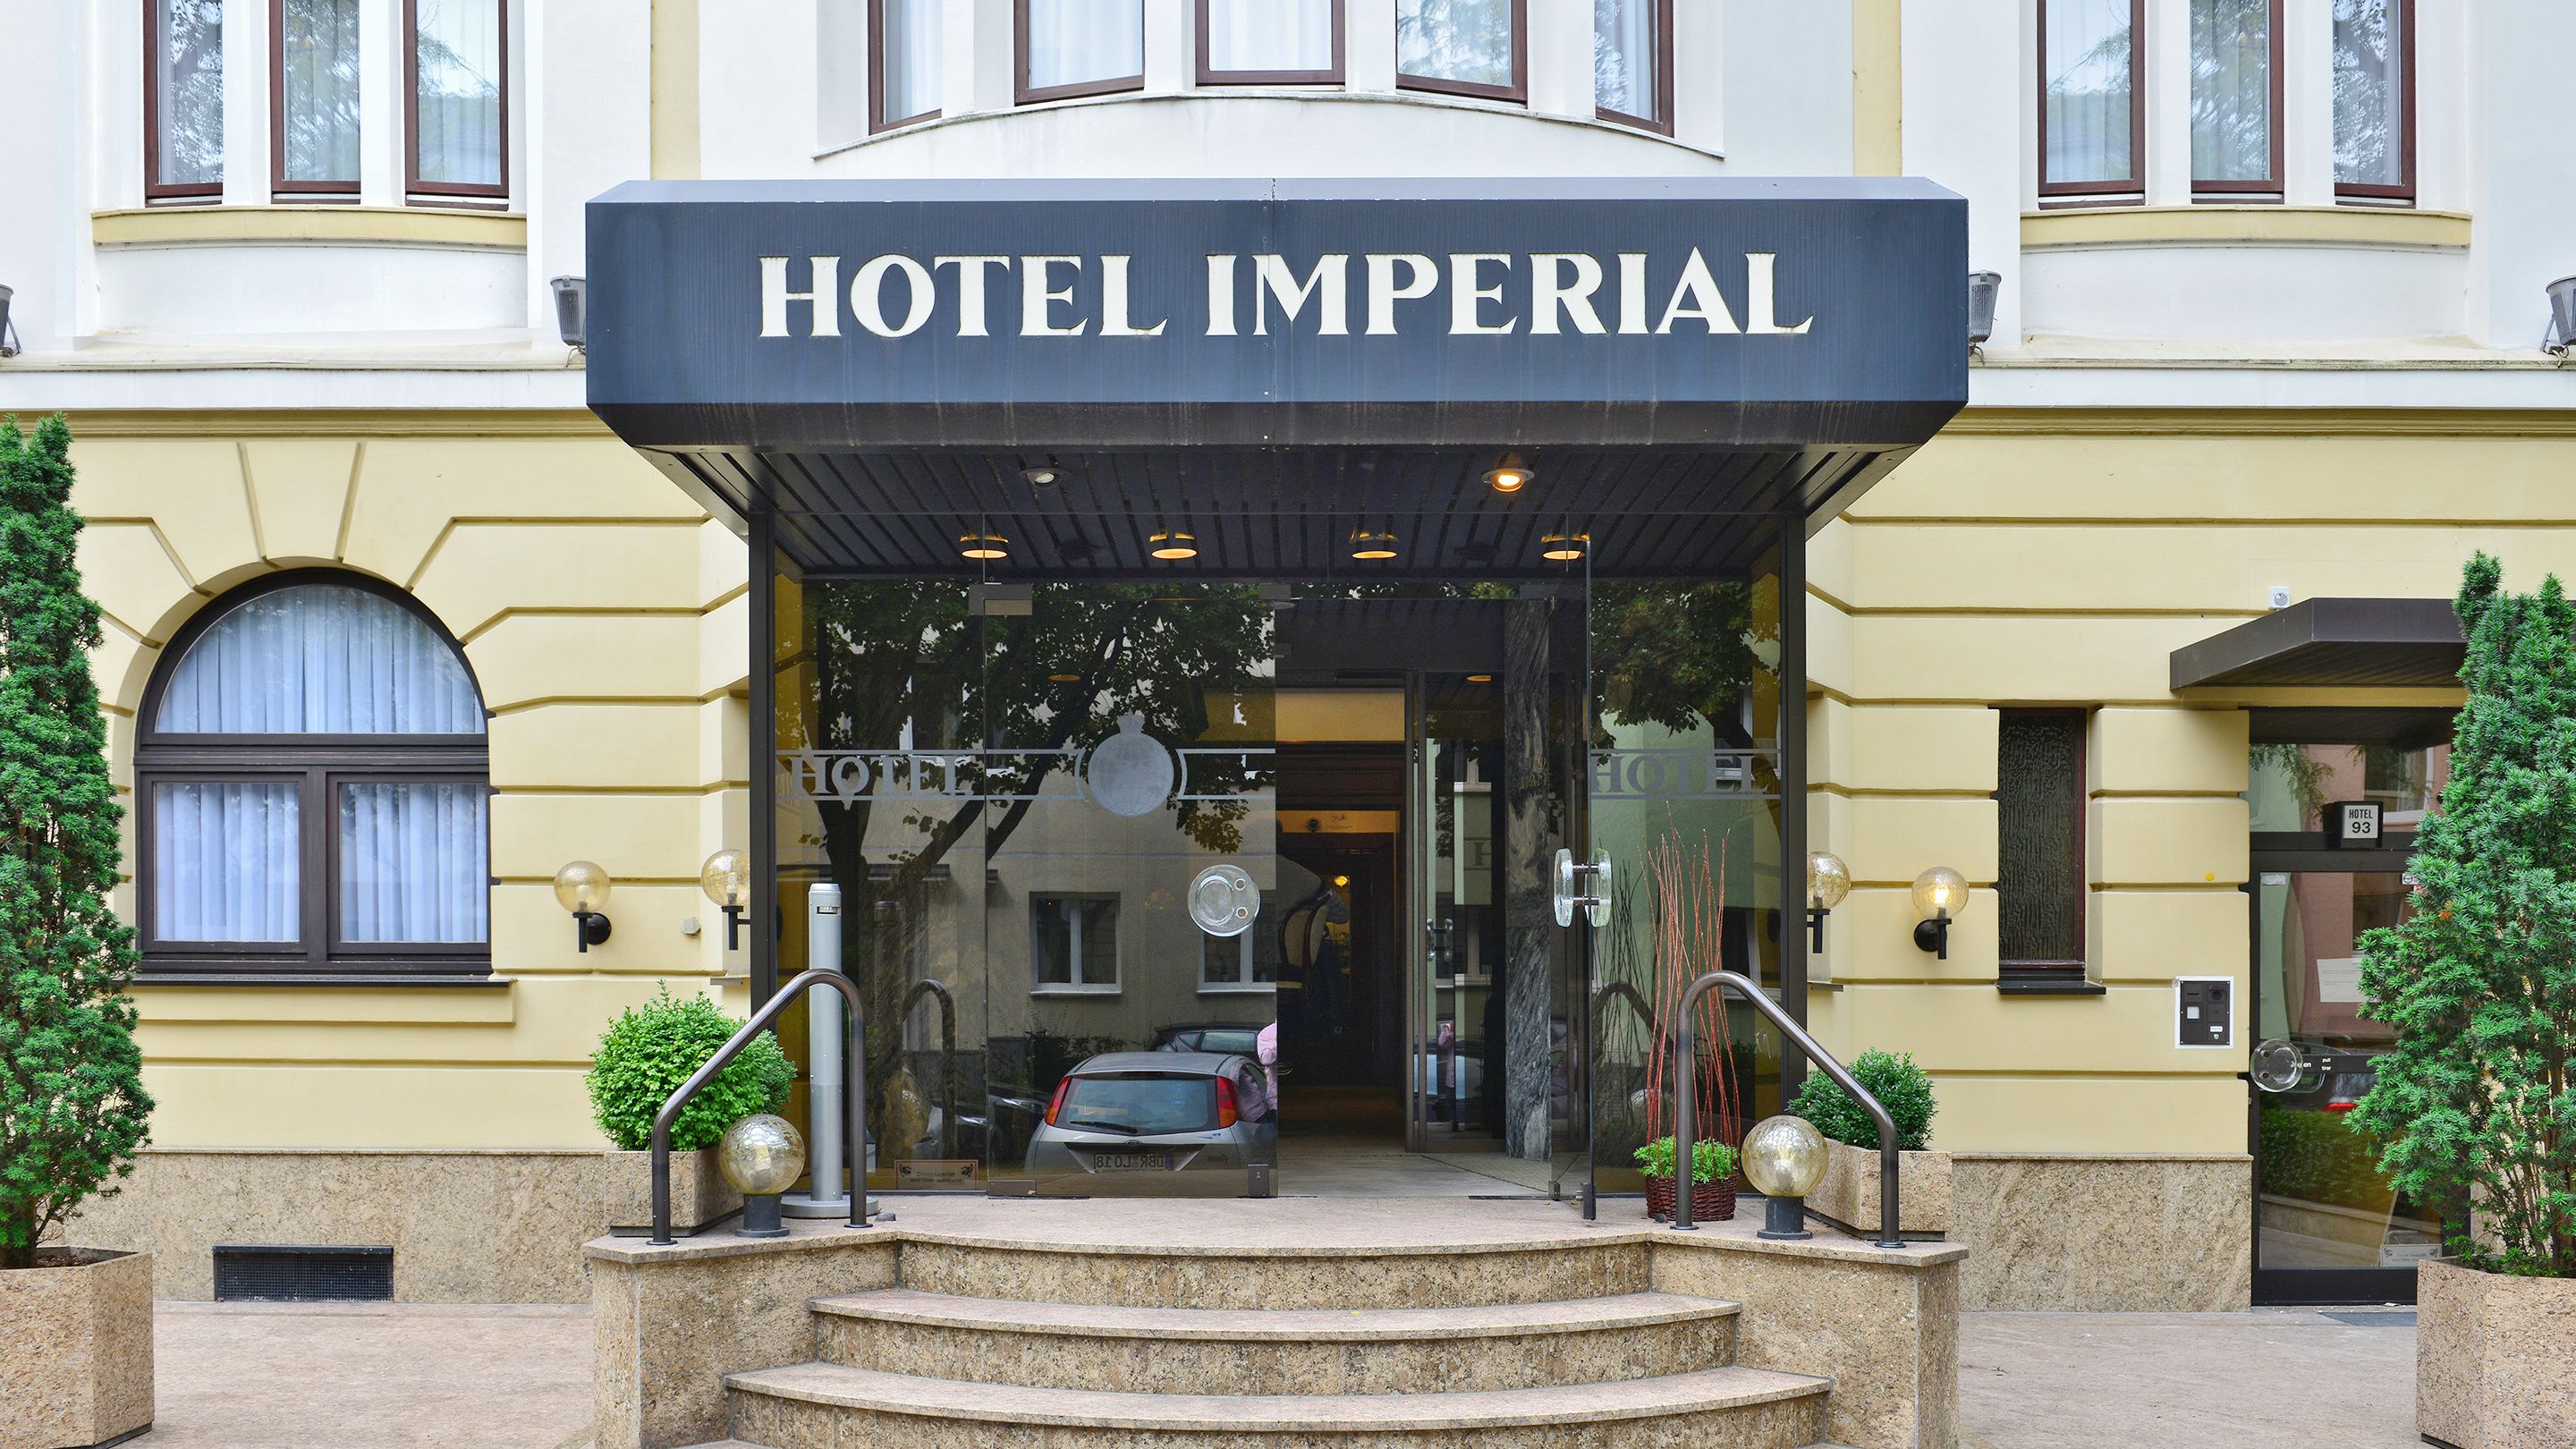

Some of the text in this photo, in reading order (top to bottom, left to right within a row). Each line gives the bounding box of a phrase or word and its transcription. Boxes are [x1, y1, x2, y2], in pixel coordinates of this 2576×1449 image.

[758, 246, 1814, 338] HOTEL IMPERIAL
[788, 755, 973, 795] HOTEL
[1590, 754, 1768, 793] HOTEL
[2349, 809, 2373, 819] HOTEL
[2351, 821, 2371, 834] 93
